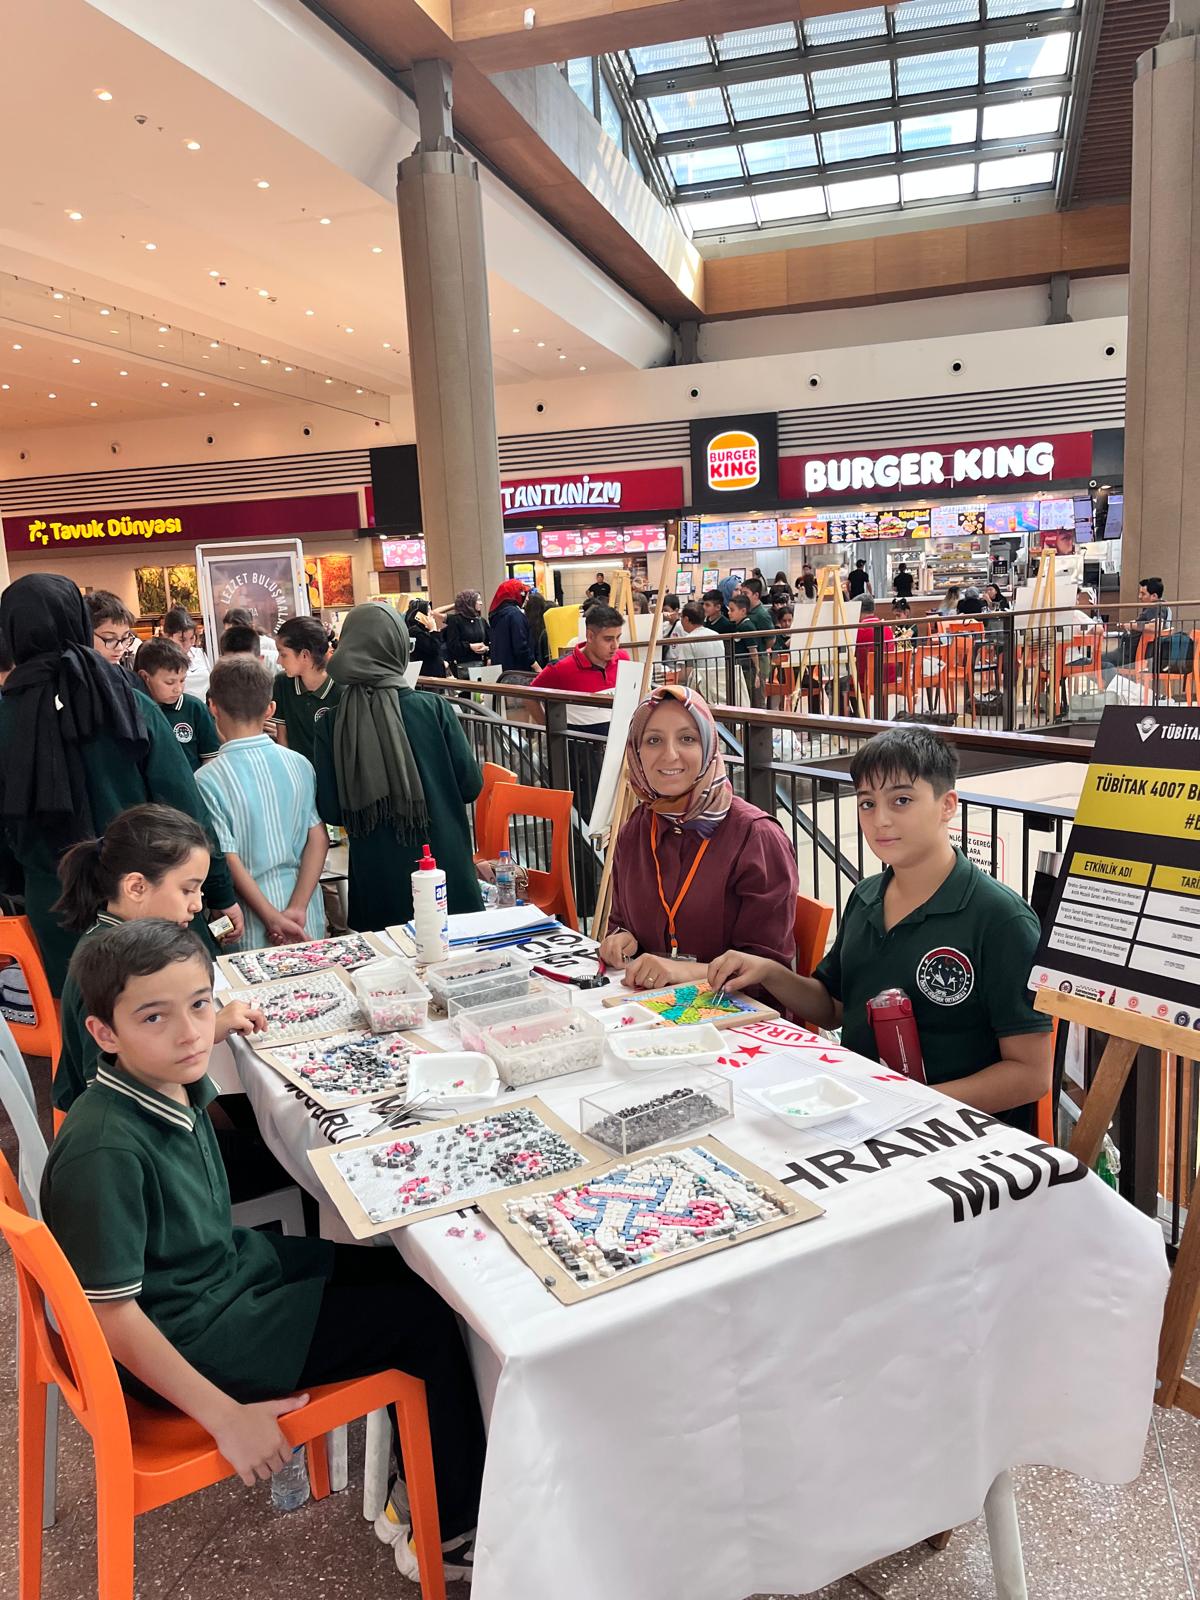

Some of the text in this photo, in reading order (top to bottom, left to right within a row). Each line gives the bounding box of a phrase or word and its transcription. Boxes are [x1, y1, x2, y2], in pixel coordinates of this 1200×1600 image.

[709, 449, 757, 463] BURGER
[710, 462, 757, 479] KING
[805, 442, 1055, 493] BURGER KING
[501, 475, 622, 509] TANTUNİZM
[50, 516, 182, 541] Tavuk Dünyası
[221, 573, 248, 605] LEZZET
[1161, 723, 1200, 740] TÜBİTA
[1096, 773, 1200, 801] TÜBİTAK 4007 B
[1084, 860, 1133, 878] ETKİNLİK ADI
[1181, 875, 1200, 889] TARİ
[744, 1023, 819, 1043] TURİZ
[779, 1107, 1012, 1190] HRAMA
